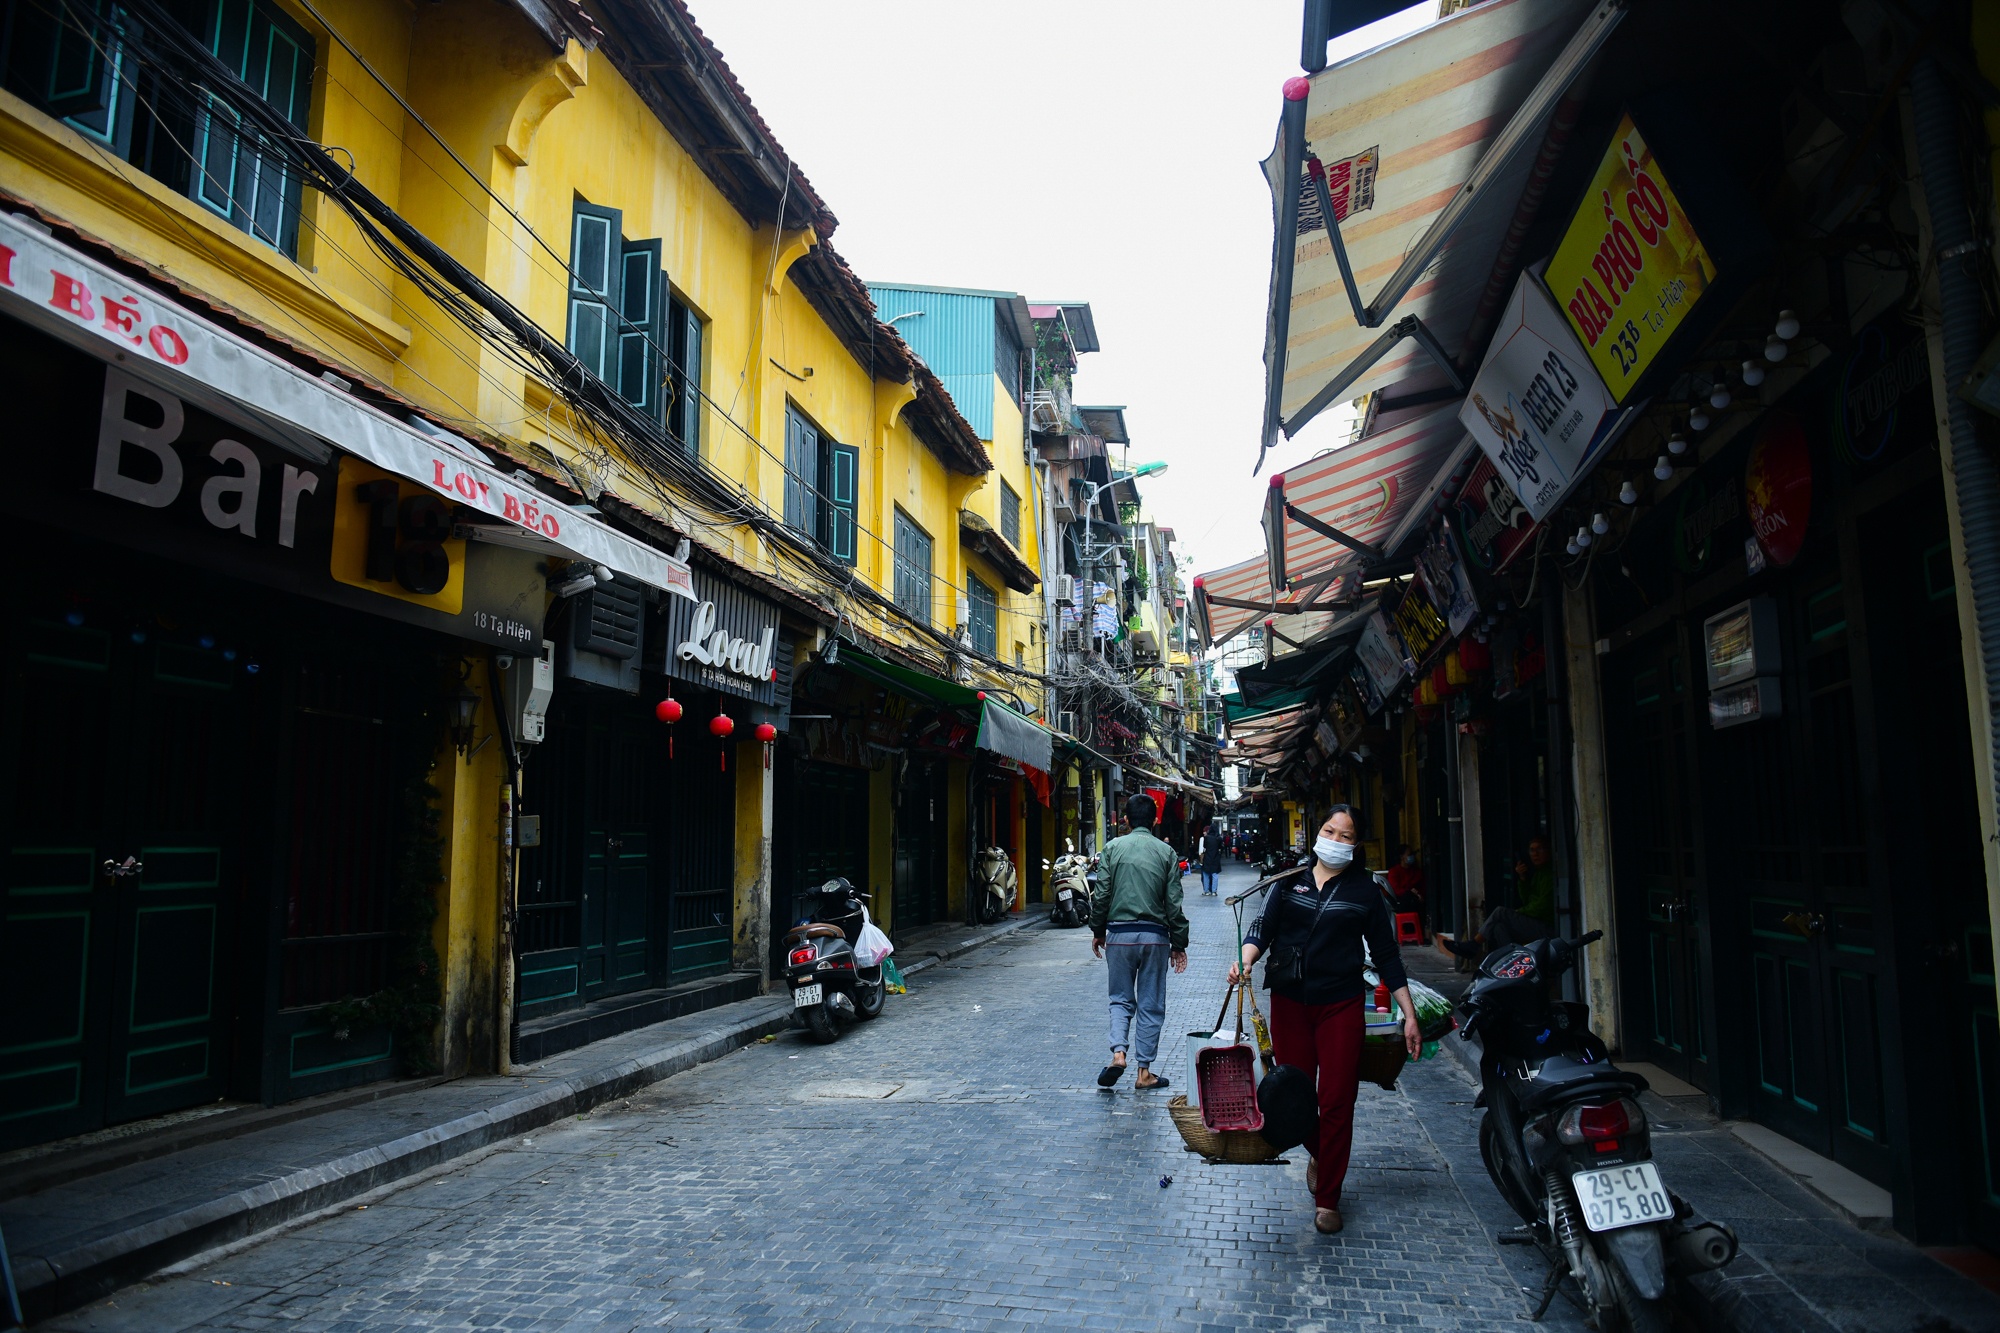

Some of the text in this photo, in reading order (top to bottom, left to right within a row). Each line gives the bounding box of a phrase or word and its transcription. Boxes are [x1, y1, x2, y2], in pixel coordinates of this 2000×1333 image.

[1568, 140, 1670, 348] BIA PHỐ CỔ
[48, 269, 189, 365] BÉO
[1610, 278, 1688, 377] 23B Tạ Hiện
[1521, 350, 1579, 436] BEER 23
[93, 363, 320, 549] Bar
[1500, 428, 1540, 484] Tiger
[503, 492, 560, 539] BÉO
[1536, 477, 1561, 507] CRYSTAL
[474, 611, 531, 642] 18 Tạ Hiện
[677, 601, 774, 681] Local
[1587, 1167, 1648, 1198] 29-C1
[1597, 1158, 1623, 1166] HONDA
[1589, 1192, 1667, 1226] 875.80
